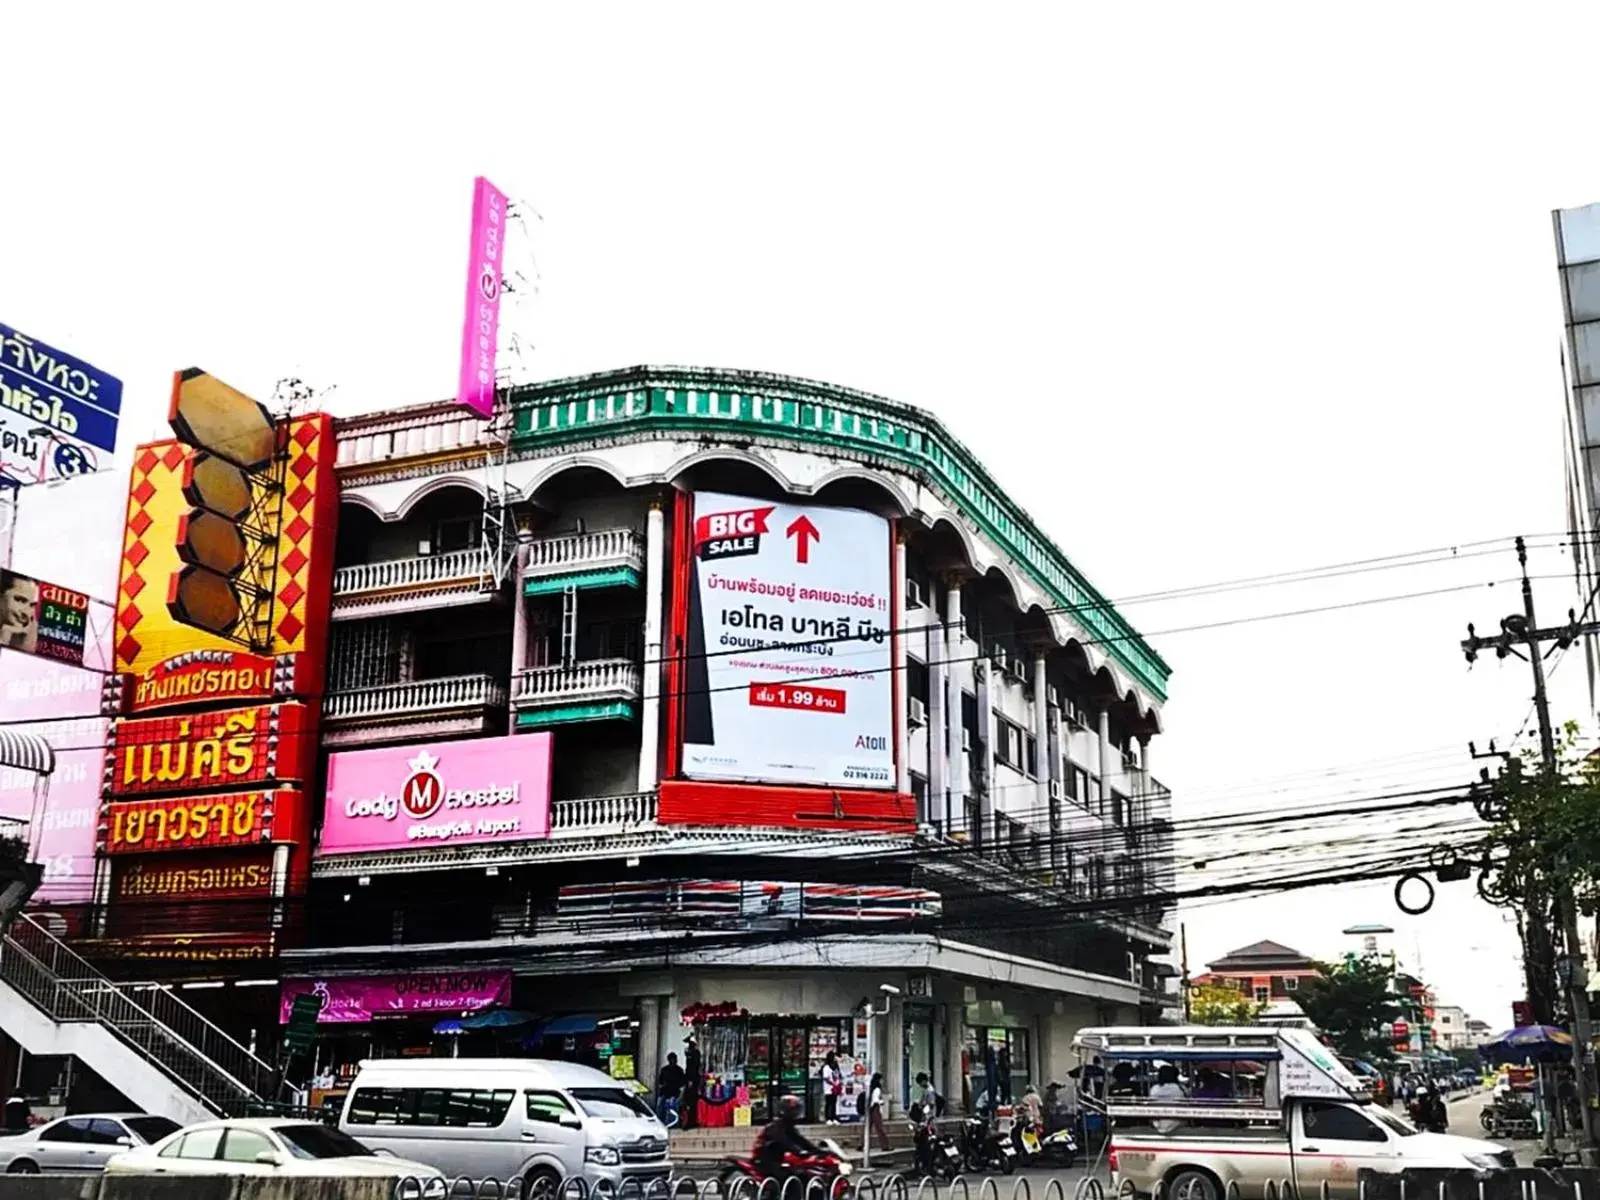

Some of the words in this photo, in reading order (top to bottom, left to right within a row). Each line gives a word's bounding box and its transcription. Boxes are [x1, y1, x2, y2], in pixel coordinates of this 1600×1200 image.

[0, 332, 99, 400] จังหวะ
[709, 512, 755, 537] BIG
[709, 538, 754, 554] SALE
[707, 574, 796, 603] บ้านพร้อมอยู่
[721, 604, 784, 632] เอโทล
[791, 616, 851, 639] บาหลี
[778, 690, 814, 705] 1.99
[123, 709, 258, 785] แม่ศรี
[855, 735, 886, 750] Atoll
[410, 777, 433, 808] M
[113, 793, 258, 844] เยาวราช
